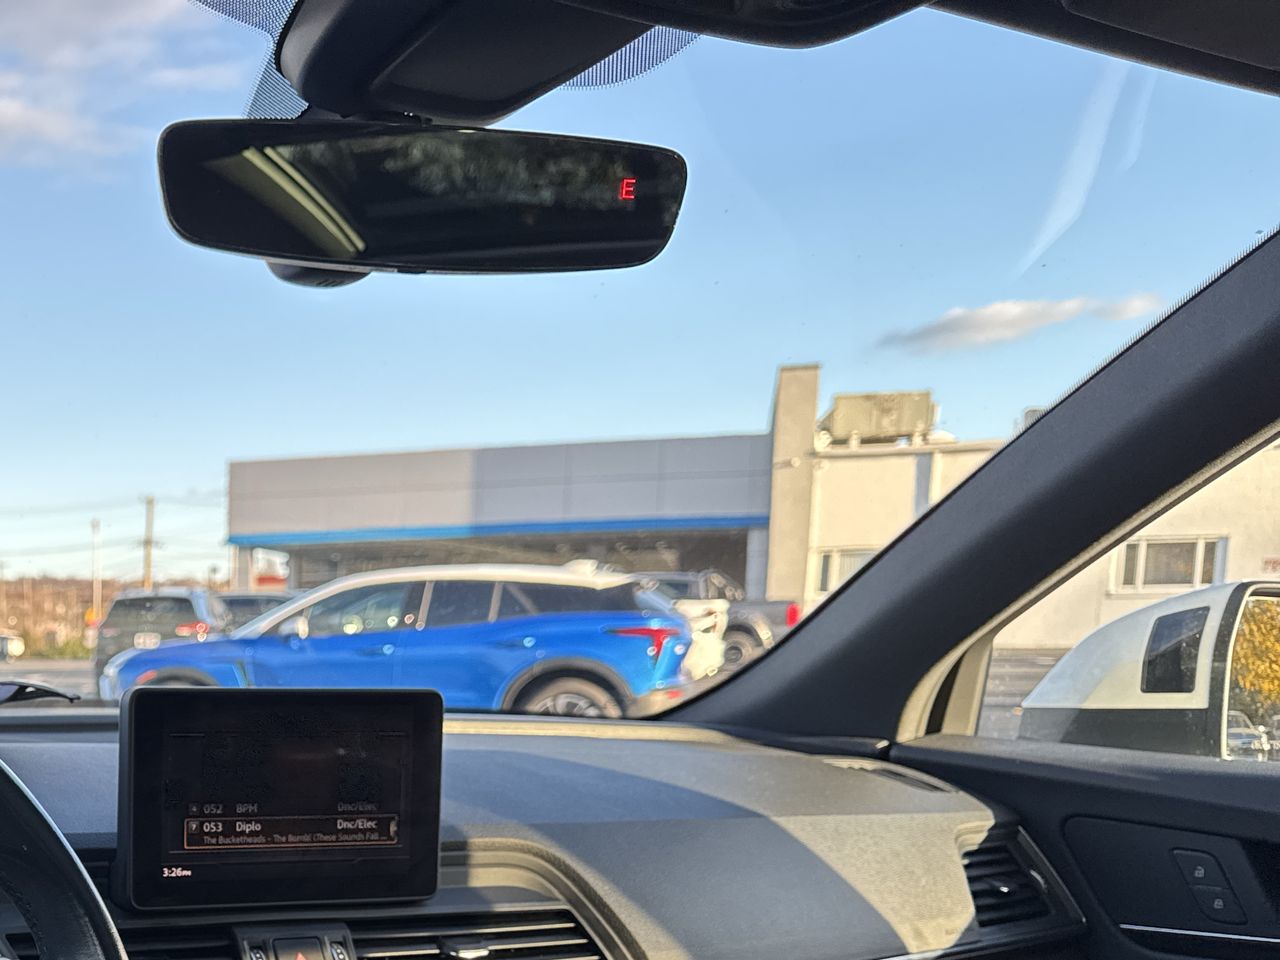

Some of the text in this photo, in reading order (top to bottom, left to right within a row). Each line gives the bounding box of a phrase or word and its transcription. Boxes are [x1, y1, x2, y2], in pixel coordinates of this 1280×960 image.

[618, 178, 638, 200] E
[203, 803, 223, 814] 052
[235, 802, 258, 813] BPM
[203, 822, 223, 833] 053
[235, 821, 262, 834] Diplo
[336, 818, 378, 830] Dnc/Elec
